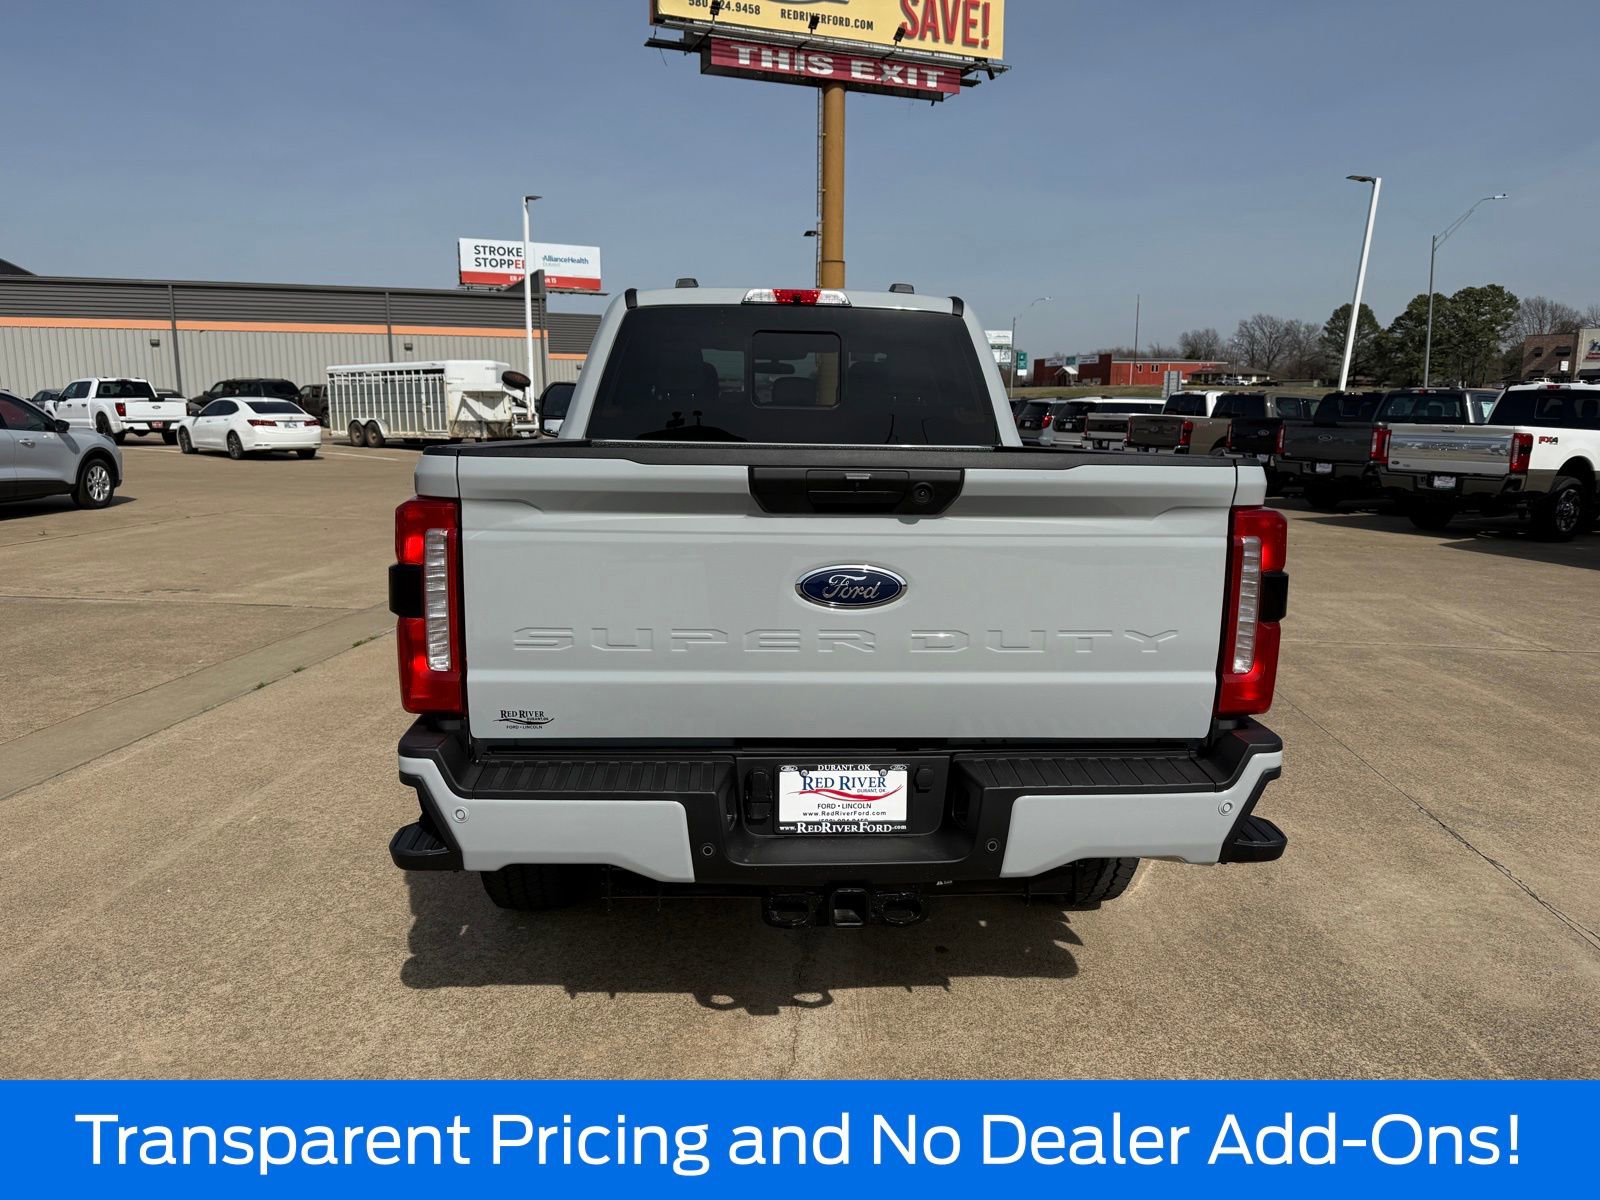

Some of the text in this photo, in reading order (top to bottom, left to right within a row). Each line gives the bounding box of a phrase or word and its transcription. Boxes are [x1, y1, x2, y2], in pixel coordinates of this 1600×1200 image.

[900, 0, 990, 49] SAVE!
[730, 45, 945, 88] THIS EXIT
[473, 245, 523, 257] STROKE
[542, 255, 589, 265] AllianceHealth
[822, 574, 882, 599] Ford
[513, 627, 1178, 653] SUPER DUTY
[500, 710, 545, 719] RED RIVER
[801, 775, 887, 791] RED RIVER
[841, 802, 872, 810] LINCOLN
